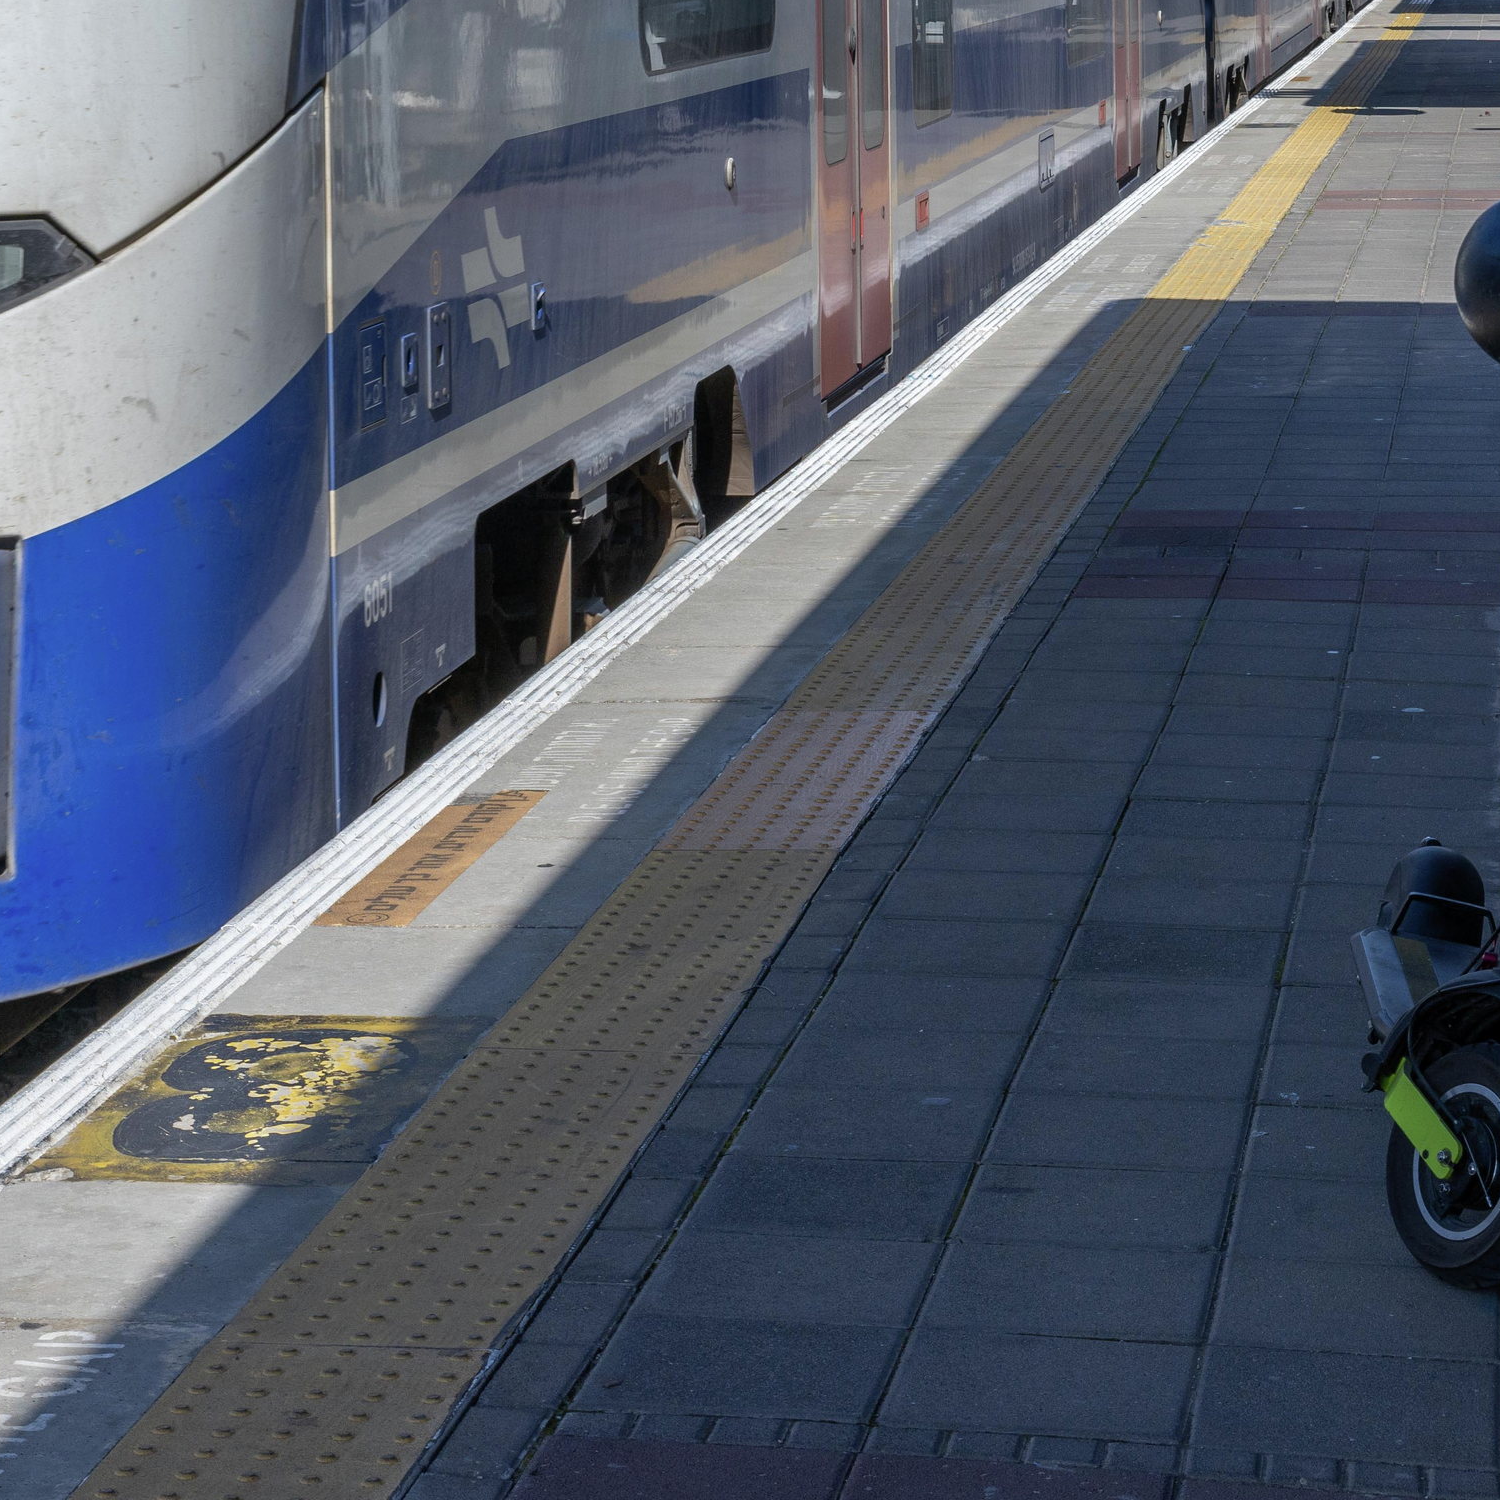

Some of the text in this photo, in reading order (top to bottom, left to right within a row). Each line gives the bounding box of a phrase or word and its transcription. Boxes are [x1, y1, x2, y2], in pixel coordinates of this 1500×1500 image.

[363, 570, 393, 628] 6051
[648, 717, 706, 735] GAP
[629, 737, 691, 754] THE
